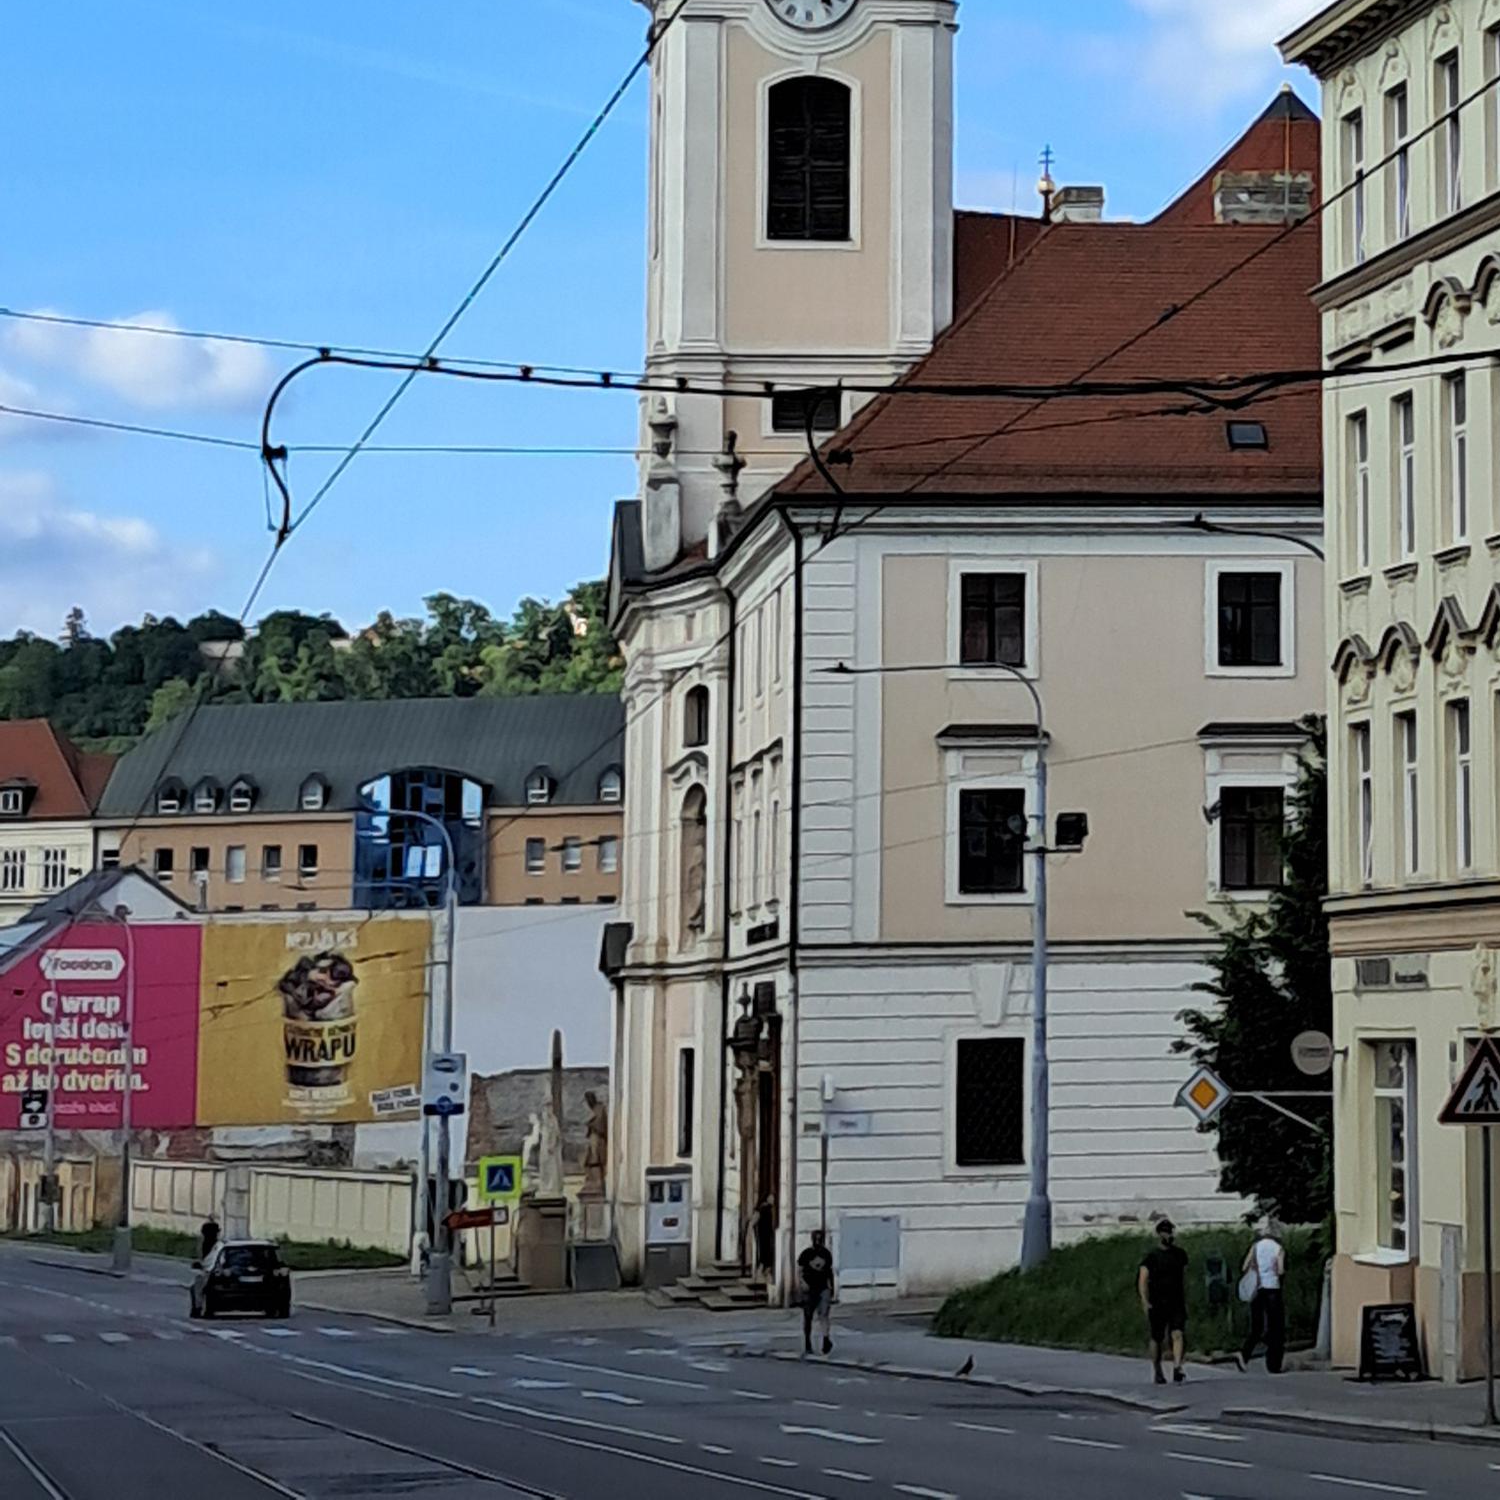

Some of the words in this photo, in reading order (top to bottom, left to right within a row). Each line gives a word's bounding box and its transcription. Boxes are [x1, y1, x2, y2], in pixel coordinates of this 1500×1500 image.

[61, 995, 121, 1018] wrap
[5, 1042, 21, 1066] S
[284, 1032, 355, 1063] WRAPU
[2, 1069, 29, 1092] až
[32, 1069, 59, 1091] ke
